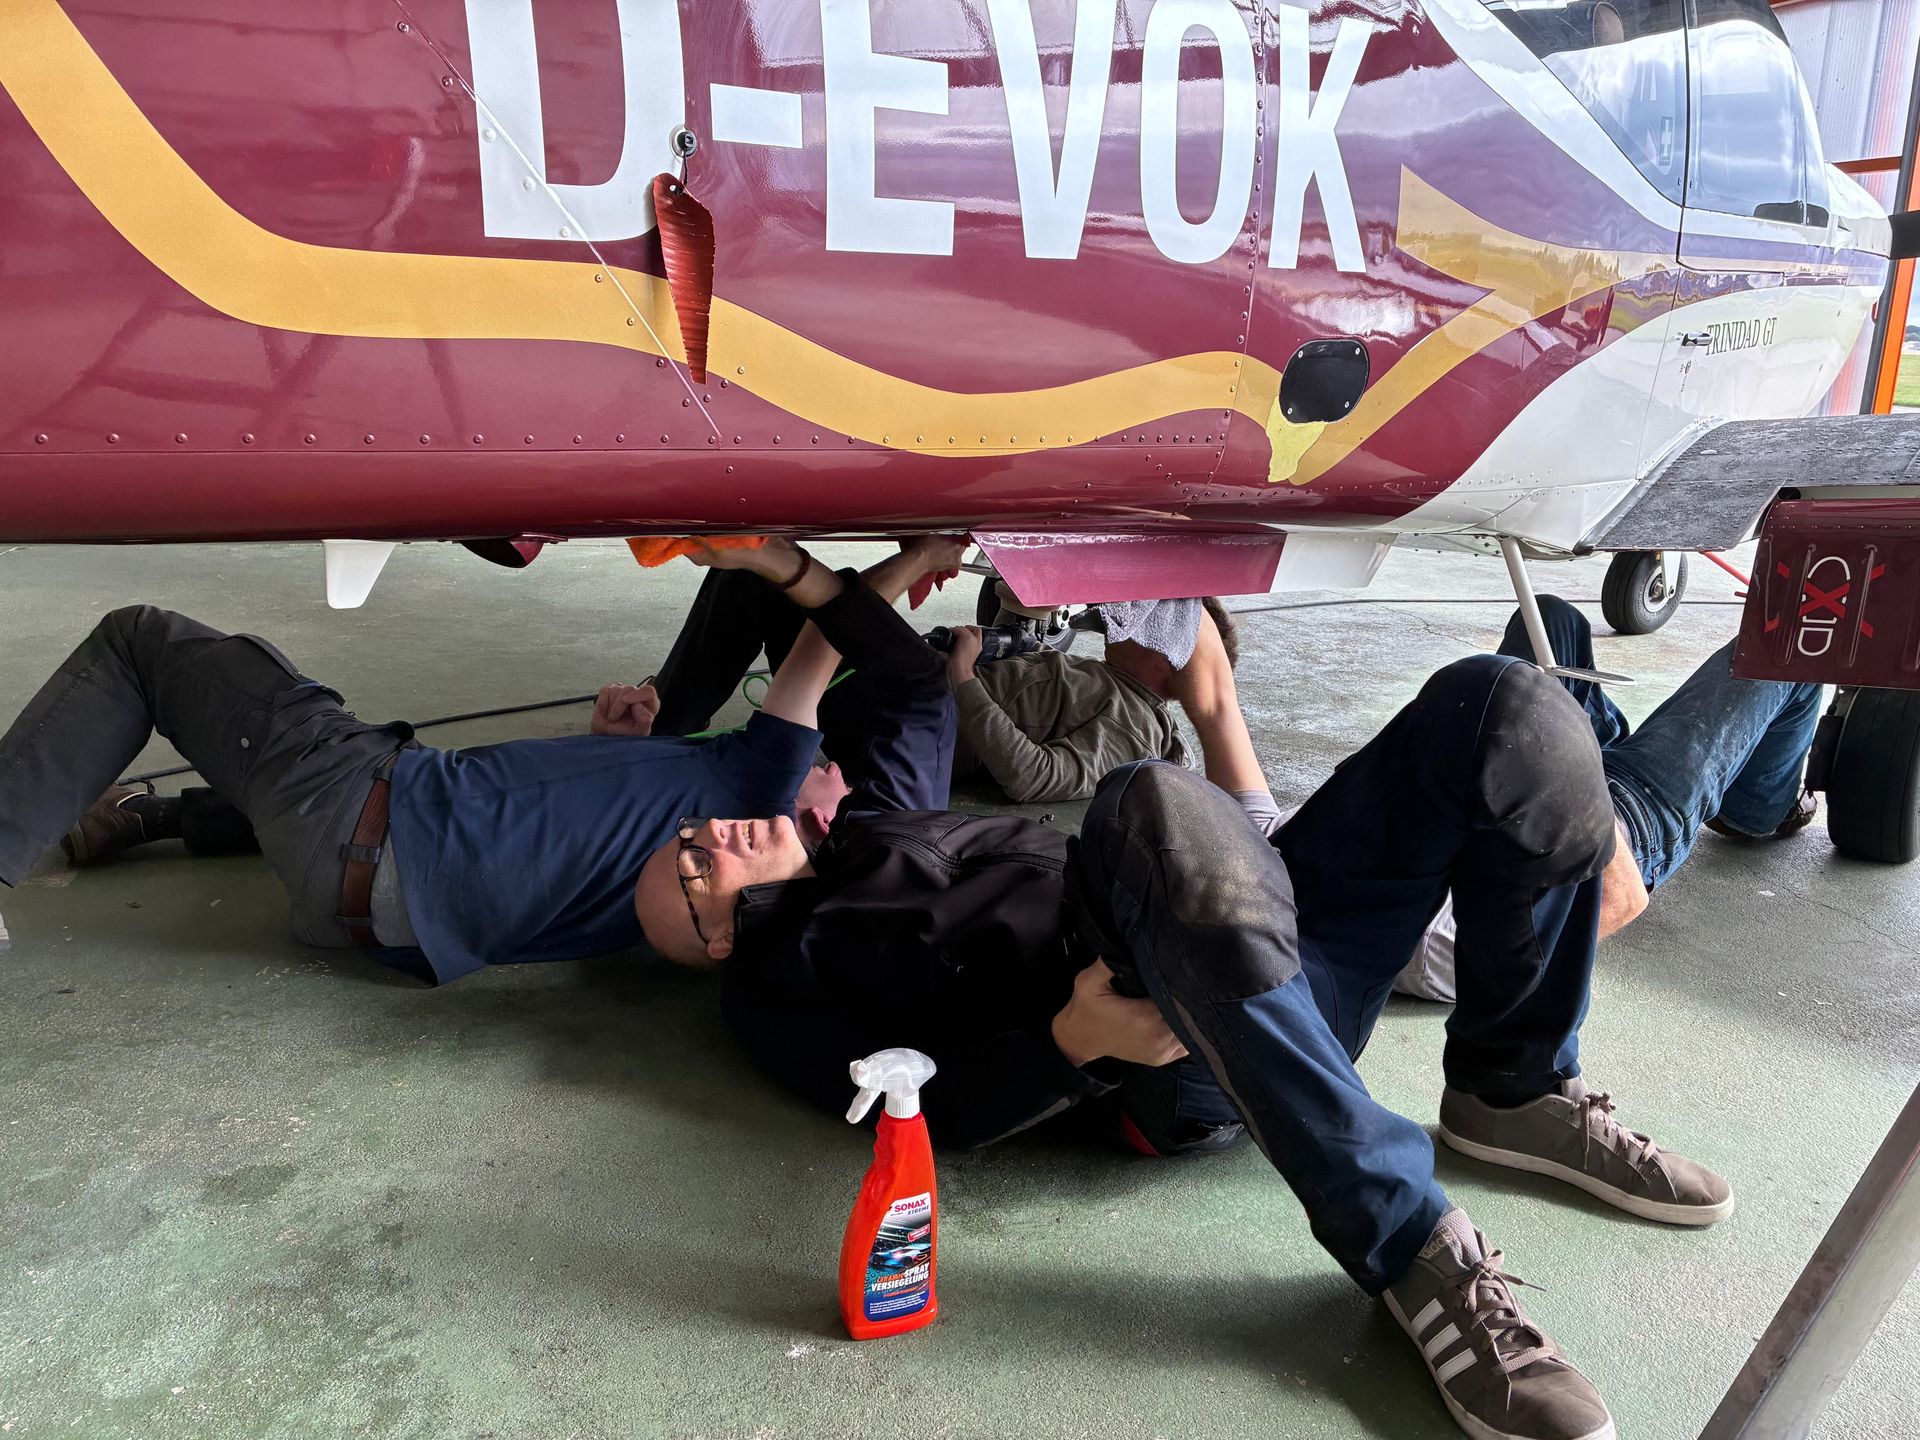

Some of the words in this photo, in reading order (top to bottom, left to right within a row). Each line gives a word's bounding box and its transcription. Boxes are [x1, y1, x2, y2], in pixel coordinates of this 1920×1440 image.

[466, 0, 1375, 272] D-EVOK
[1705, 319, 1761, 355] TRINIDAD
[1763, 317, 1777, 345] GT
[894, 1199, 926, 1212] SONAX
[1417, 1232, 1453, 1259] didas
[871, 1270, 930, 1292] VERSIEGELUNG
[904, 1262, 930, 1277] SPRAY
